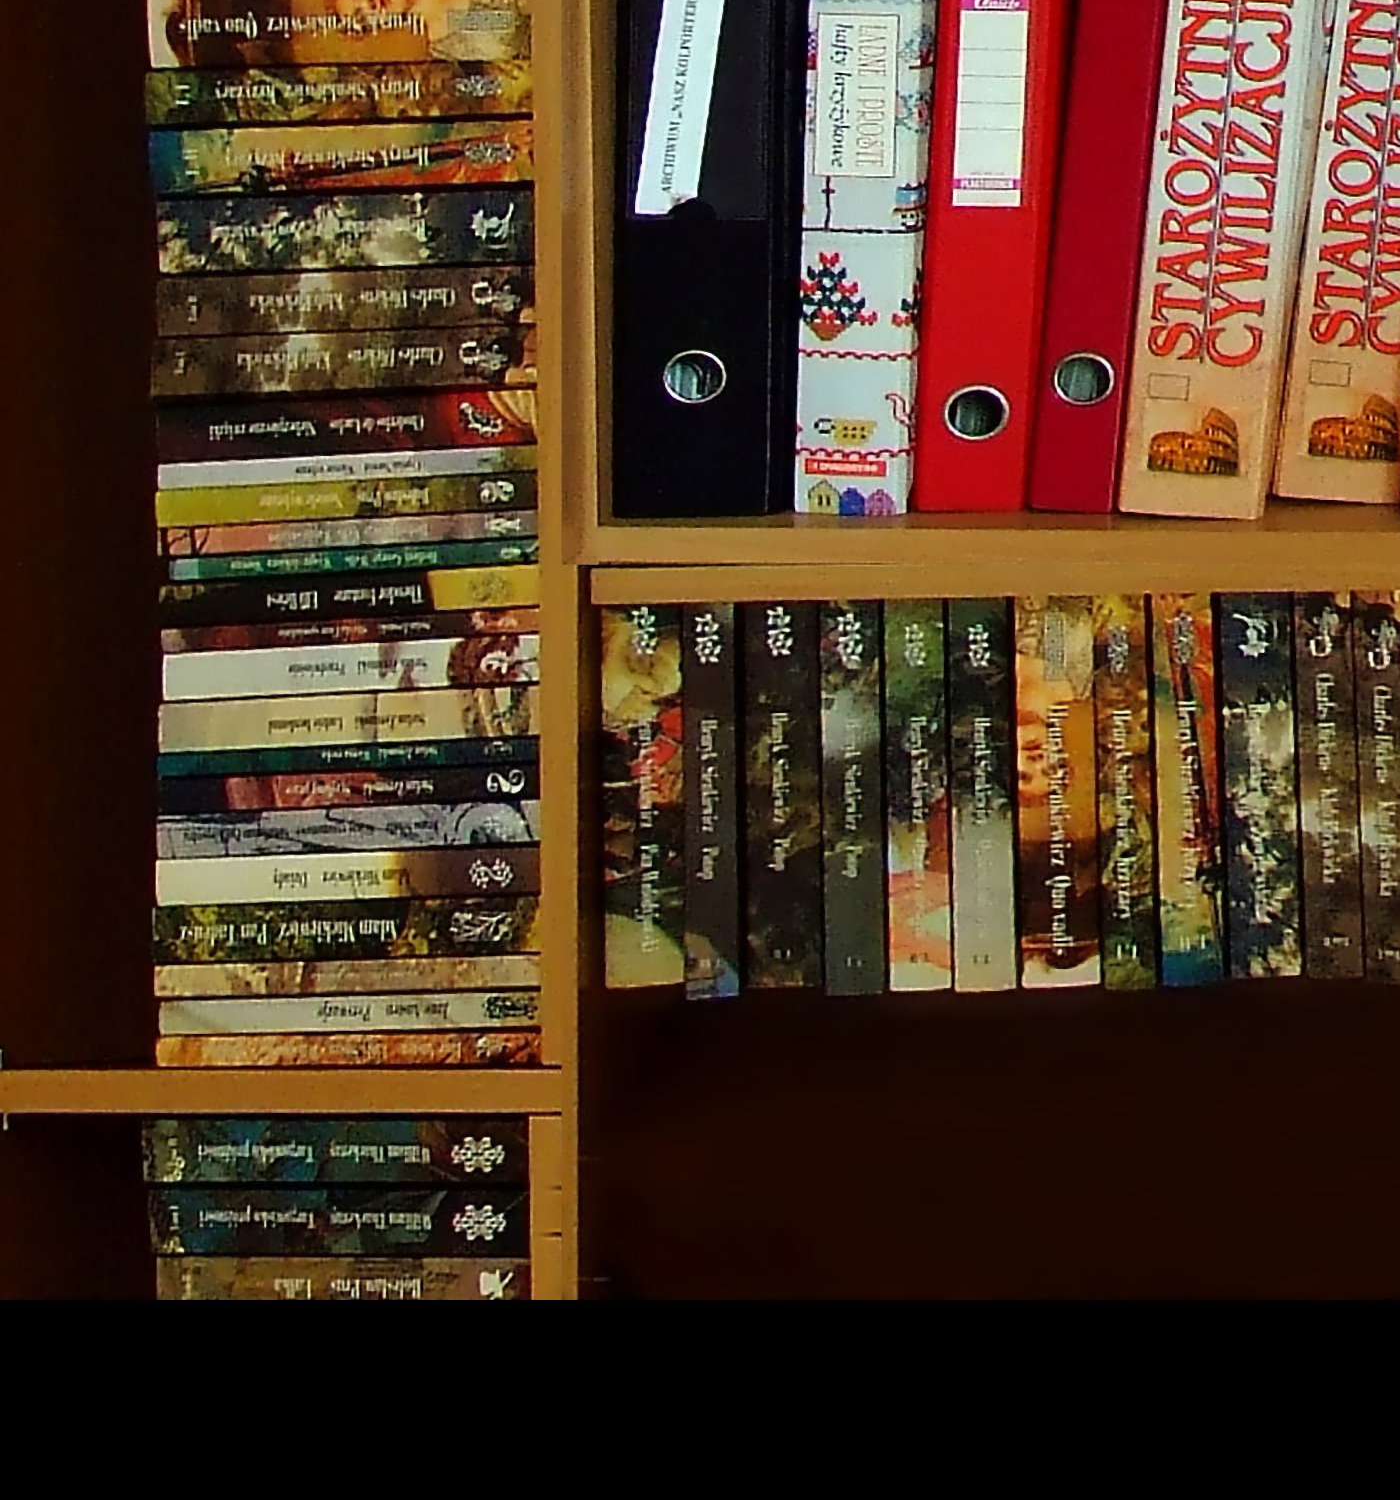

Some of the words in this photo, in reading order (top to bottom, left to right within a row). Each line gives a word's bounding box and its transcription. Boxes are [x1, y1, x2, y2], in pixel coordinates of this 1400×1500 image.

[831, 24, 853, 63] hafty
[858, 24, 887, 76] ŁADNE
[831, 73, 852, 168] krzyżykowe
